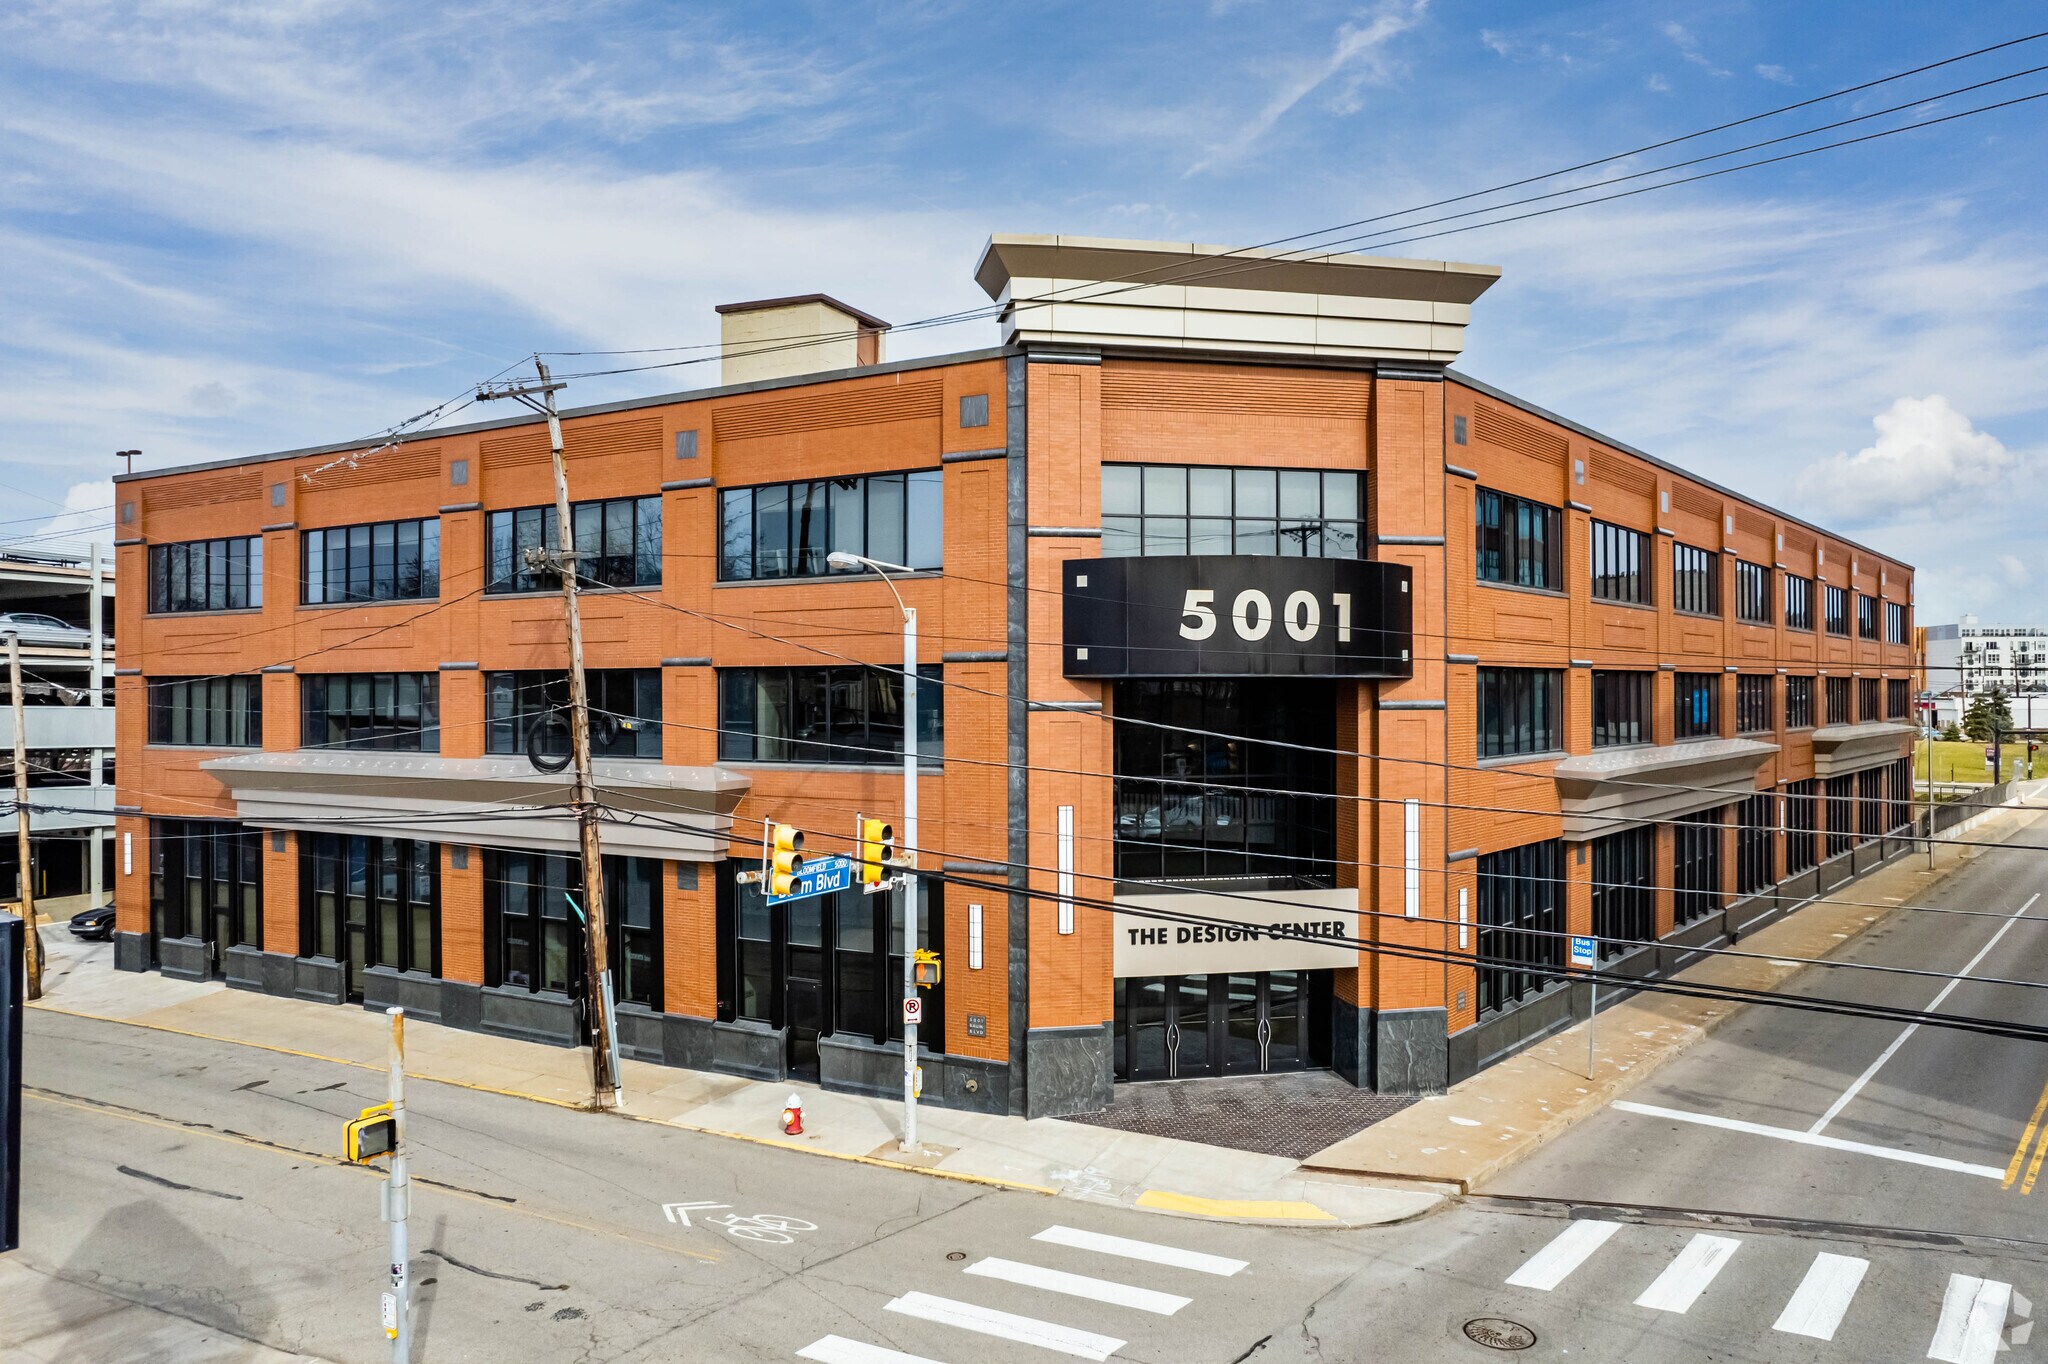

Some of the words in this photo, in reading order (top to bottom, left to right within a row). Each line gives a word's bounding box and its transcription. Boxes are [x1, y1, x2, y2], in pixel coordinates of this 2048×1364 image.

[1179, 588, 1351, 643] 5001
[816, 870, 840, 891] Blvd
[1128, 927, 1168, 945] THE
[1176, 923, 1259, 944] DESIGN
[1268, 920, 1346, 941] CENTER
[1576, 938, 1590, 946] Bus
[1573, 945, 1592, 955] Stop
